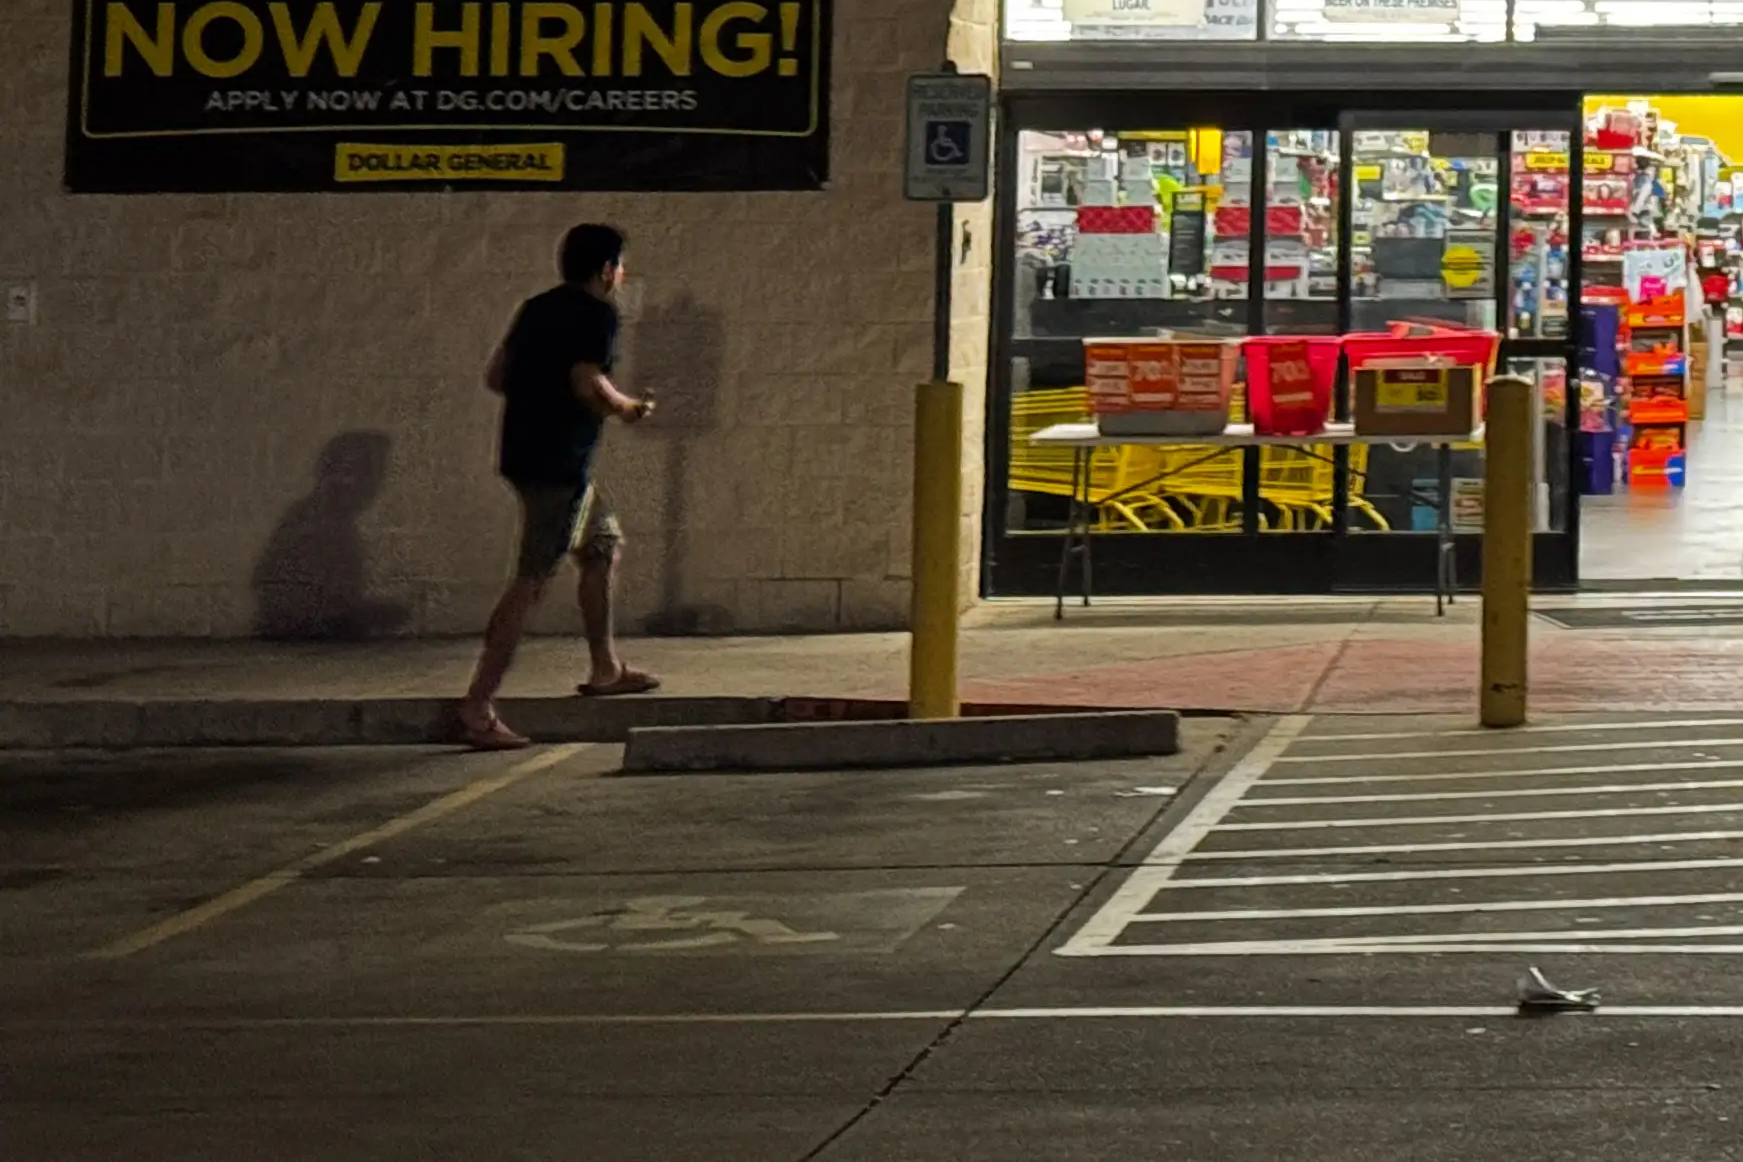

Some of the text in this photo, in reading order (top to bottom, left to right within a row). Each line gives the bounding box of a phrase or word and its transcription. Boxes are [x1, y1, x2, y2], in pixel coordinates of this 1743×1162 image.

[104, 0, 800, 78] NOW HIRING!
[204, 88, 698, 112] APPLY NOW AT DG.COM/CAREERS
[347, 151, 552, 172] DOLLAR GENERAL
